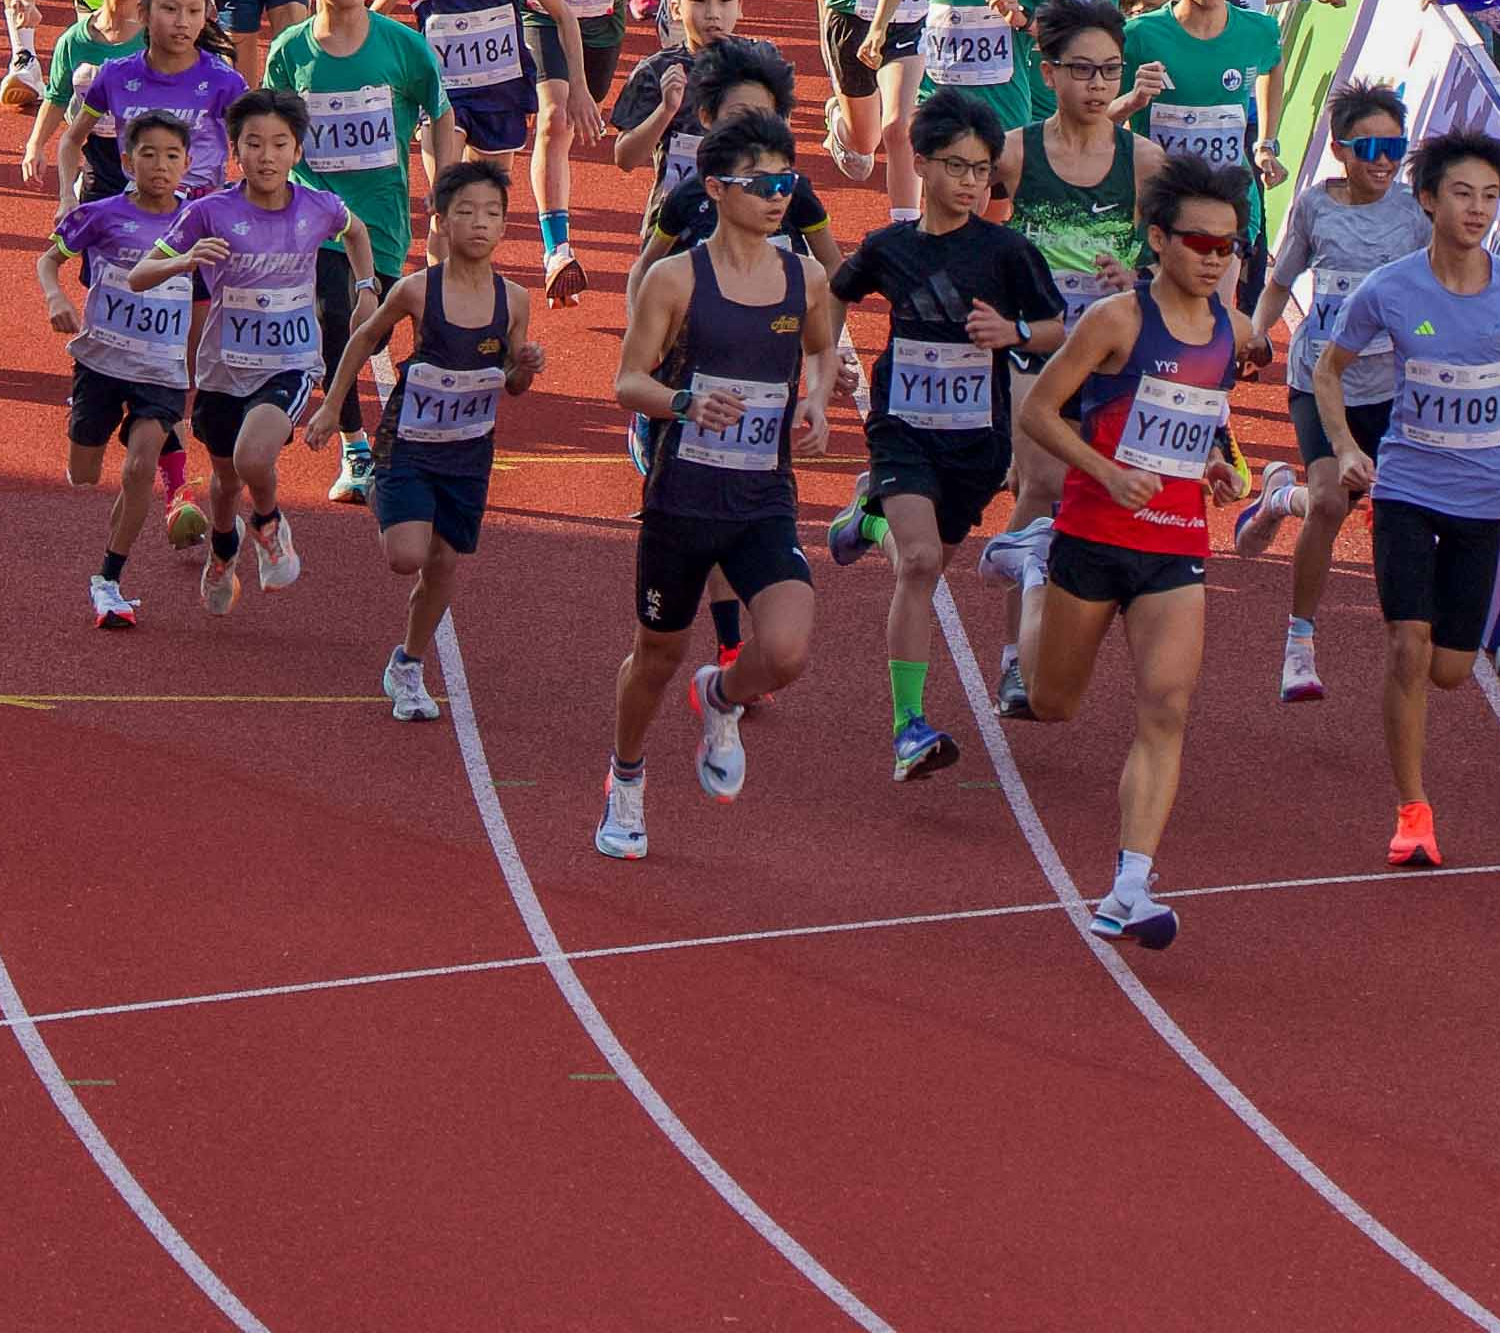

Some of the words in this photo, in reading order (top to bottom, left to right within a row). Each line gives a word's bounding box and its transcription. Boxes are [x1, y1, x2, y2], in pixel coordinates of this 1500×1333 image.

[435, 34, 515, 68] Y1184
[931, 34, 1009, 63] Y1284
[309, 117, 391, 150] Y1304
[104, 294, 183, 338] Y1301
[230, 313, 311, 348] Y1300
[1154, 359, 1179, 375] YY3
[900, 372, 987, 405] Y1167
[413, 392, 494, 425] Y1141
[1410, 391, 1499, 425] Y1109
[1136, 411, 1213, 455] Y1091
